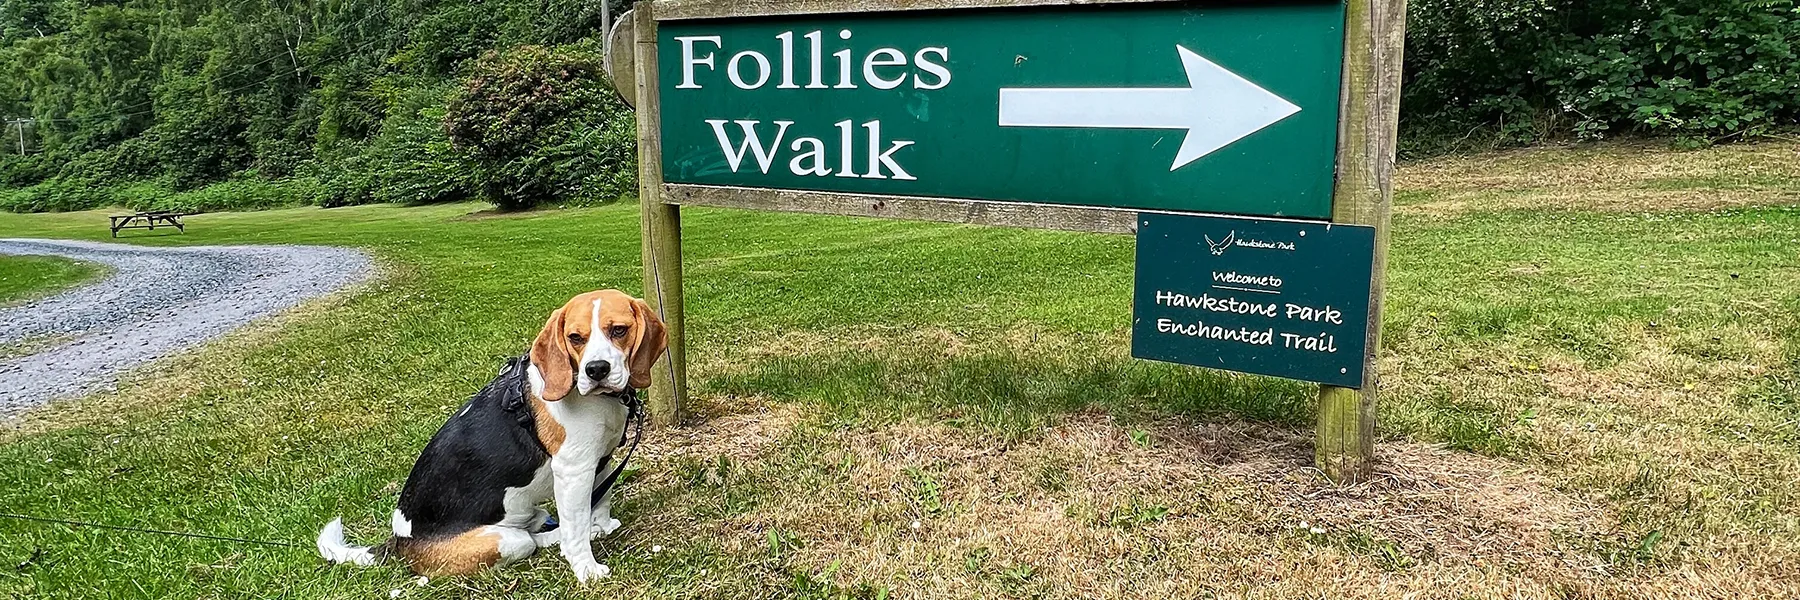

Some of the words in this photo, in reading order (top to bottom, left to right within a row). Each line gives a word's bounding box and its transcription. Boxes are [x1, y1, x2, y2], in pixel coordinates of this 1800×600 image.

[673, 29, 951, 90] Follies
[705, 119, 917, 180] Walk
[1276, 240, 1296, 251] Park
[1212, 271, 1268, 286] Welcome
[1268, 275, 1282, 287] to
[1155, 290, 1277, 318] Hawkstone
[1285, 302, 1343, 325] Park
[1157, 318, 1273, 346] Enchanted
[1280, 331, 1337, 353] Trail
